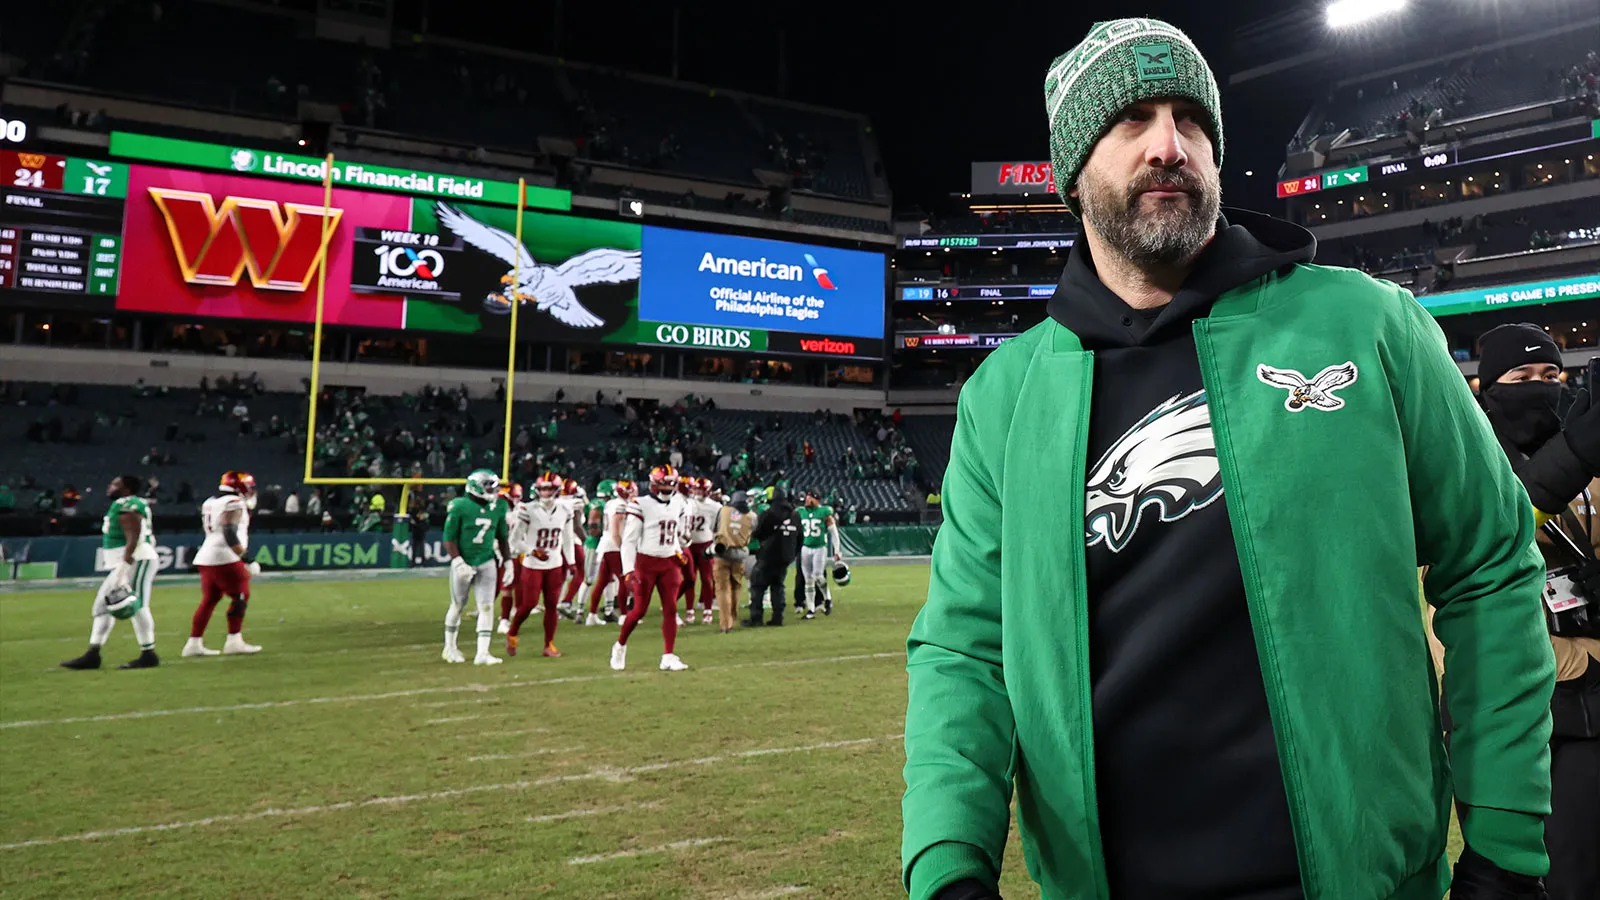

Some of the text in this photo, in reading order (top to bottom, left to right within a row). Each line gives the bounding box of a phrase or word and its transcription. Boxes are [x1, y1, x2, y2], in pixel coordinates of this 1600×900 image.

[1381, 153, 1448, 175] FINAL 0:00
[13, 168, 45, 188] 24
[81, 176, 112, 196] 17
[345, 165, 434, 193] Financial
[438, 175, 483, 198] Field
[1326, 174, 1340, 186] 17
[380, 230, 440, 247] WEEK 18
[698, 251, 803, 282] American
[377, 275, 438, 291] American
[980, 289, 1002, 297] FINAL
[709, 287, 825, 309] Official Airline of the
[918, 288, 930, 299] 19
[937, 288, 949, 299] 16
[1484, 292, 1509, 305] THIS
[1510, 288, 1543, 302] GAME
[1544, 286, 1556, 298] IS
[715, 299, 820, 321] Philadelphia Eagles
[656, 324, 751, 349] GO BIRDS
[800, 338, 855, 355] verizon
[471, 517, 493, 544] 7
[658, 519, 678, 546] 19
[801, 518, 822, 537] 35
[254, 542, 380, 566] AUTISM
